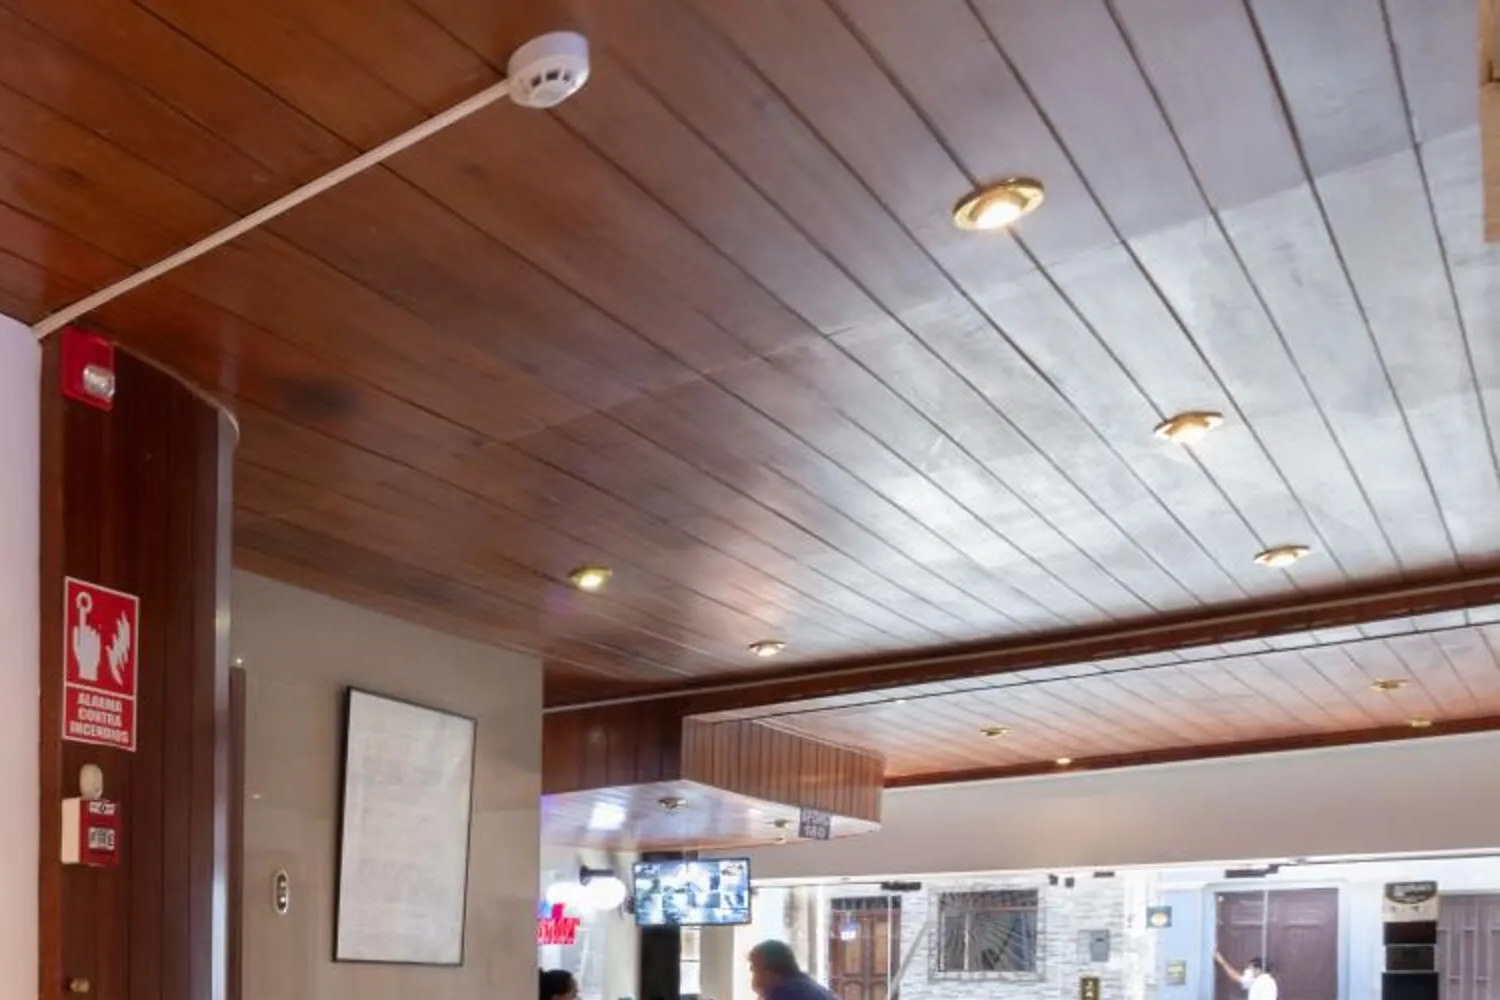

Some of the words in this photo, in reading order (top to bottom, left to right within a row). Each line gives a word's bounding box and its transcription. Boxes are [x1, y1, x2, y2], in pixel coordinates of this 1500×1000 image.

[77, 692, 122, 712] ALARMA
[77, 707, 122, 728] CONTRA
[69, 720, 129, 744] INCENDIOS
